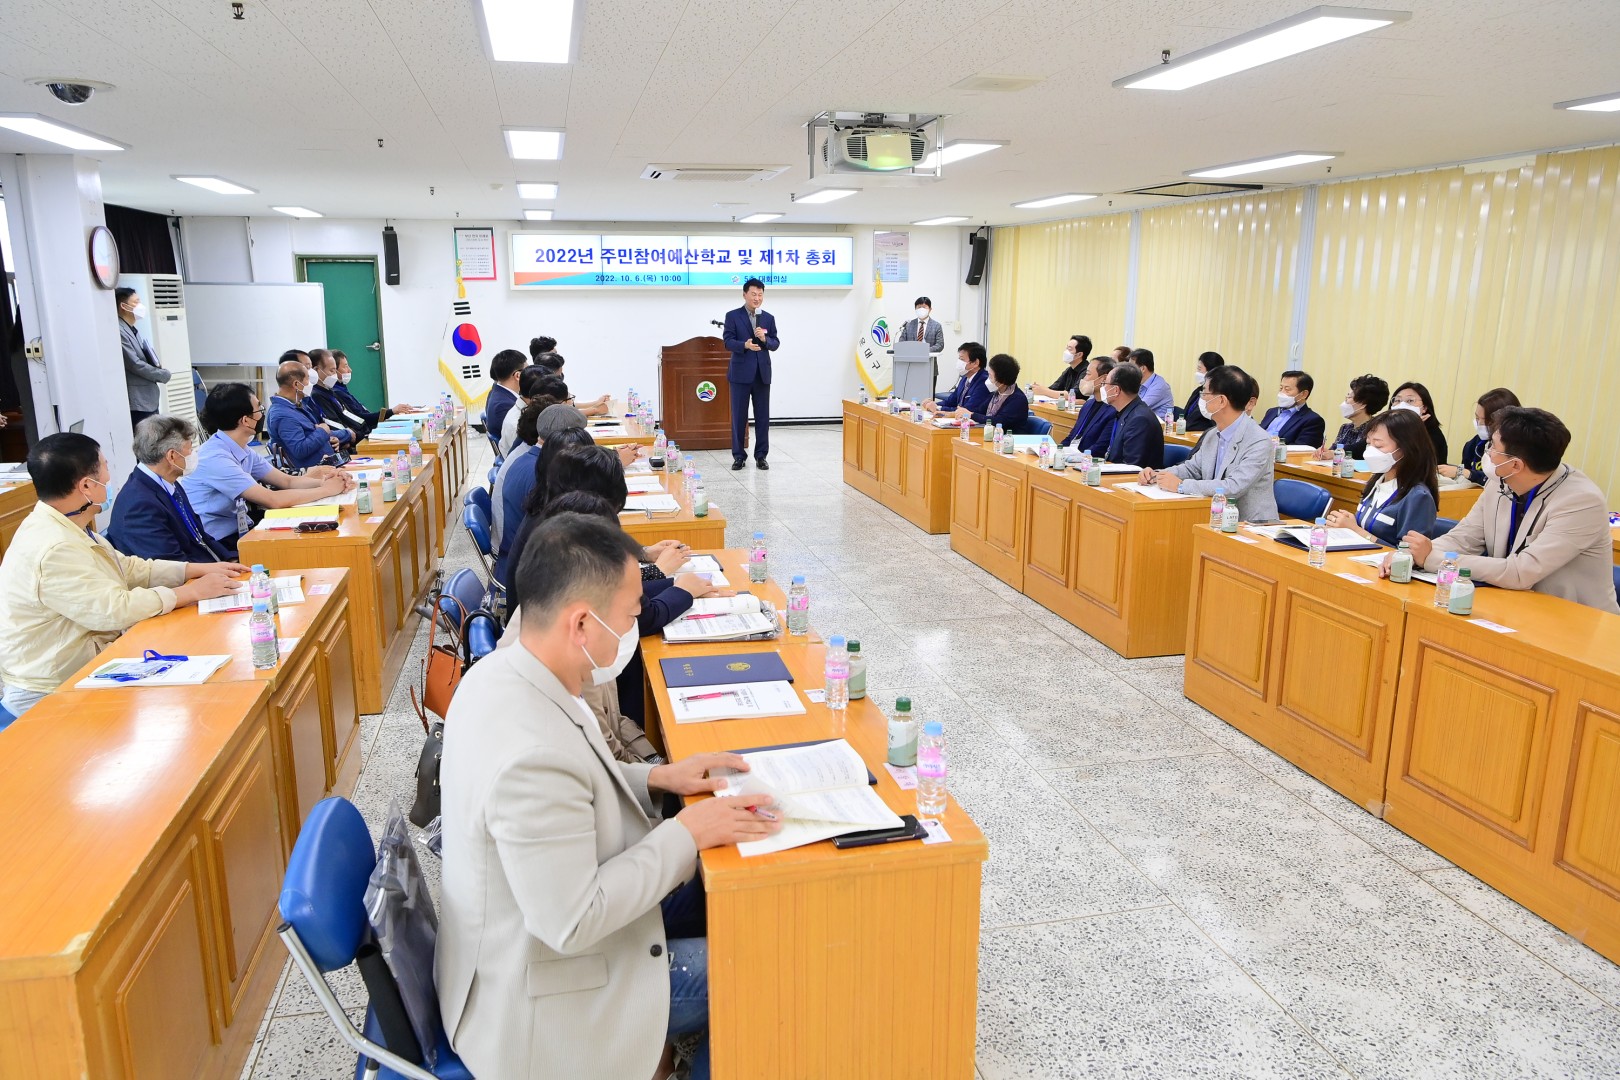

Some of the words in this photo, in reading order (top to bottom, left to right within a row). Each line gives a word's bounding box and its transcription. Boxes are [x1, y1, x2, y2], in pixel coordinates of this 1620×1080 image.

[535, 248, 594, 264] 2022년
[600, 248, 732, 265] 주민참여예산학교
[738, 249, 752, 265] 및
[759, 249, 800, 265] 제1차
[805, 249, 836, 265] 총회
